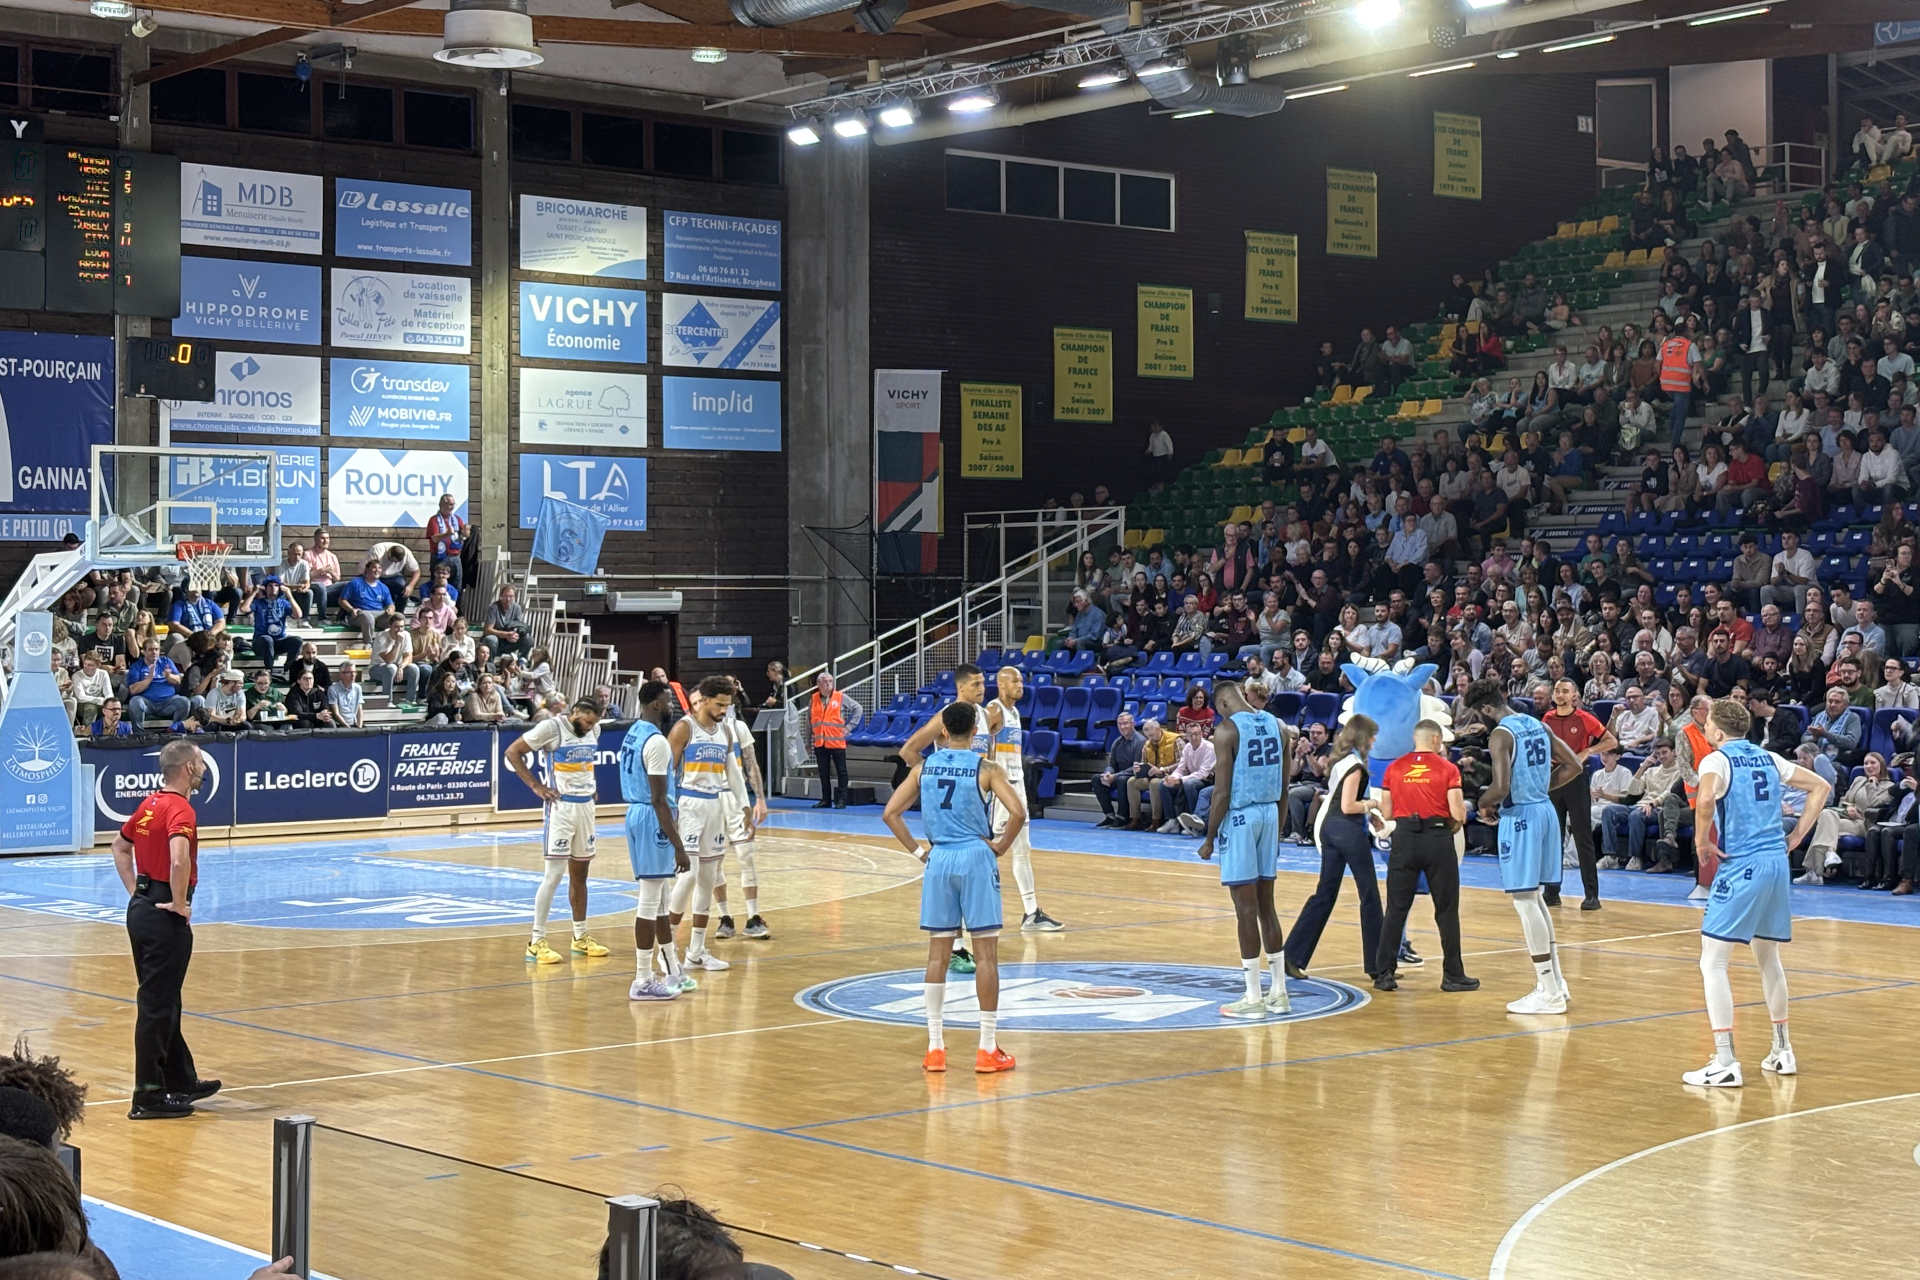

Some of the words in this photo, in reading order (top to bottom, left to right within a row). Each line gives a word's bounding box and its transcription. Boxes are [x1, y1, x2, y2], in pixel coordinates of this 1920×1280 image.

[238, 182, 294, 207] MDB
[366, 192, 470, 218] Lassalle
[361, 217, 397, 230] Logistique
[399, 221, 407, 229] et
[409, 221, 448, 233] Transports
[669, 216, 688, 226] CFP
[691, 217, 778, 236] TECHNI-FAÇADES
[411, 279, 456, 292] Location
[403, 290, 416, 299] de
[418, 291, 463, 303] vaisselle
[186, 302, 310, 321] HIPPODROME
[527, 294, 639, 328] VICHY
[1143, 300, 1186, 311] CHAMPION
[195, 316, 232, 327] VICHY
[237, 319, 301, 332] BELLERIVE
[401, 319, 415, 328] de
[1160, 313, 1169, 321] DE
[1151, 323, 1180, 333] FRANCE
[547, 328, 621, 351] Économie
[1060, 343, 1105, 353] CHAMPION
[1078, 355, 1088, 364] DE
[0, 357, 101, 384] ST-POURÇAIN
[1068, 367, 1098, 376] FRANCE
[381, 376, 450, 393] transdev
[887, 389, 929, 400] VICHY
[537, 397, 592, 410] LAGRUE
[970, 399, 1012, 409] FINALISTE
[972, 411, 1010, 421] SEMAINE
[977, 423, 992, 432] DES
[994, 423, 1007, 433] AS
[978, 453, 1004, 461] Saison
[967, 464, 988, 472] 2007
[18, 465, 92, 491] GANNA
[345, 468, 454, 497] ROUCHY
[543, 459, 630, 501] LTA
[276, 497, 299, 505] USSET
[13, 519, 50, 538] PATIO
[400, 742, 461, 757] FRANCE
[1247, 737, 1280, 767] 22
[1524, 737, 1546, 767] 26
[394, 759, 487, 777] PARE-BRISE
[921, 766, 976, 778] SHEPHERD
[244, 769, 348, 791] E.Leclerc
[427, 782, 443, 790] Paris
[1751, 770, 1770, 802] 2
[937, 779, 957, 810] 7
[1232, 814, 1246, 827] 22
[1743, 868, 1753, 880] 2
